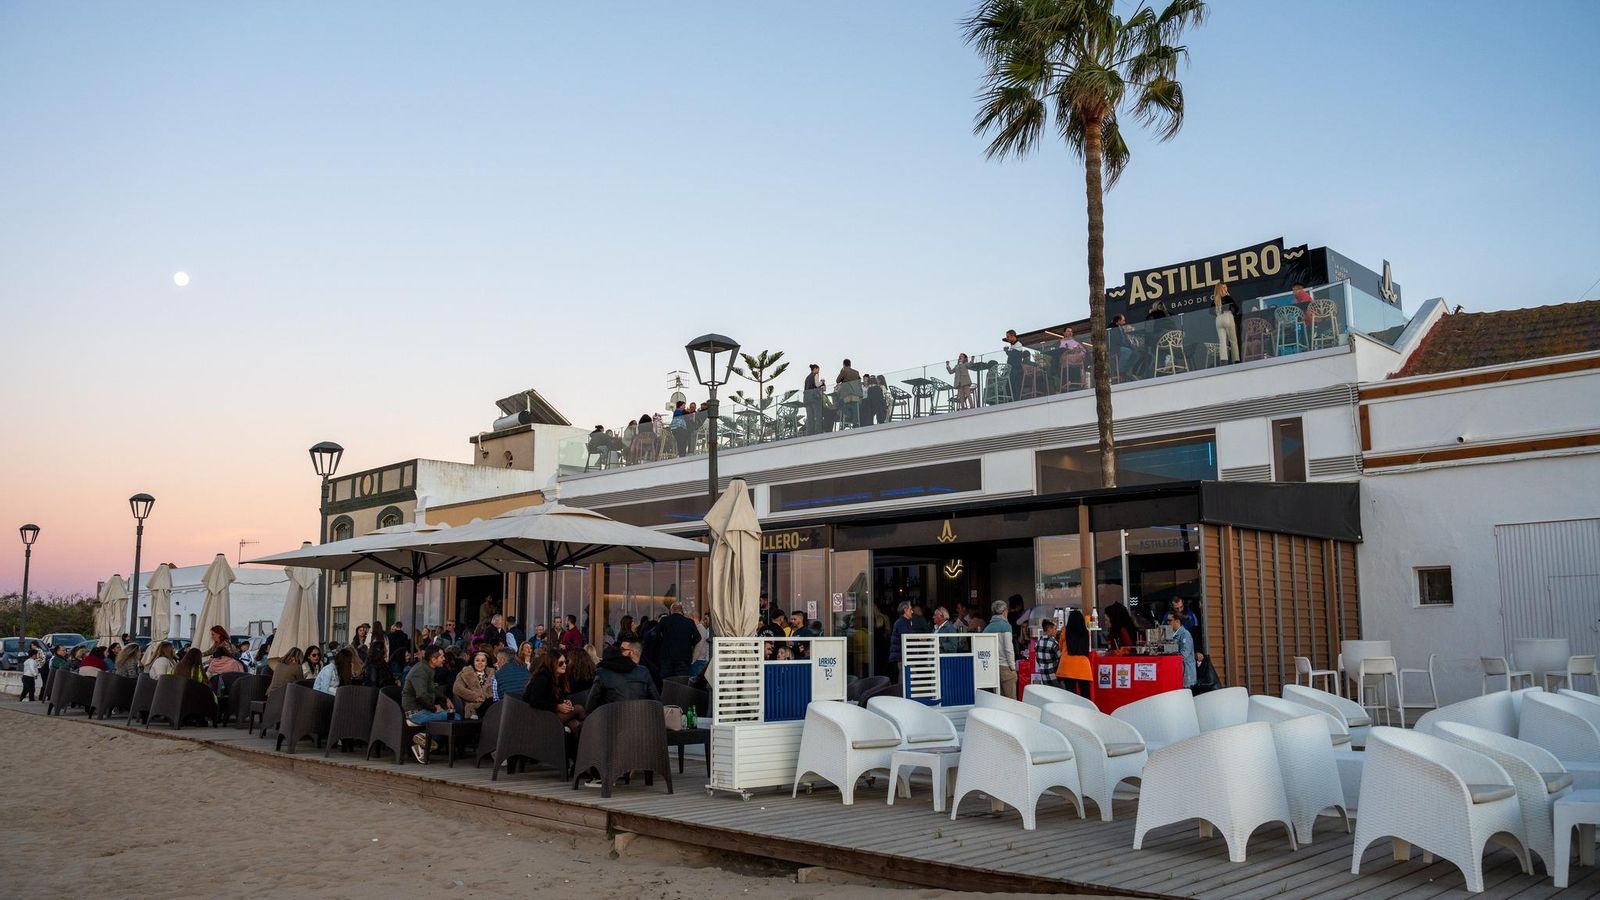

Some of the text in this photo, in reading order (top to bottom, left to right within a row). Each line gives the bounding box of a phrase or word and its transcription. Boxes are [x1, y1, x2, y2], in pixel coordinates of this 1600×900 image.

[1129, 244, 1281, 305] ASTILLERO
[1171, 298, 1194, 309] BAJO
[1196, 295, 1208, 304] DE
[762, 531, 800, 550] LLERO
[818, 657, 837, 667] LARIOS
